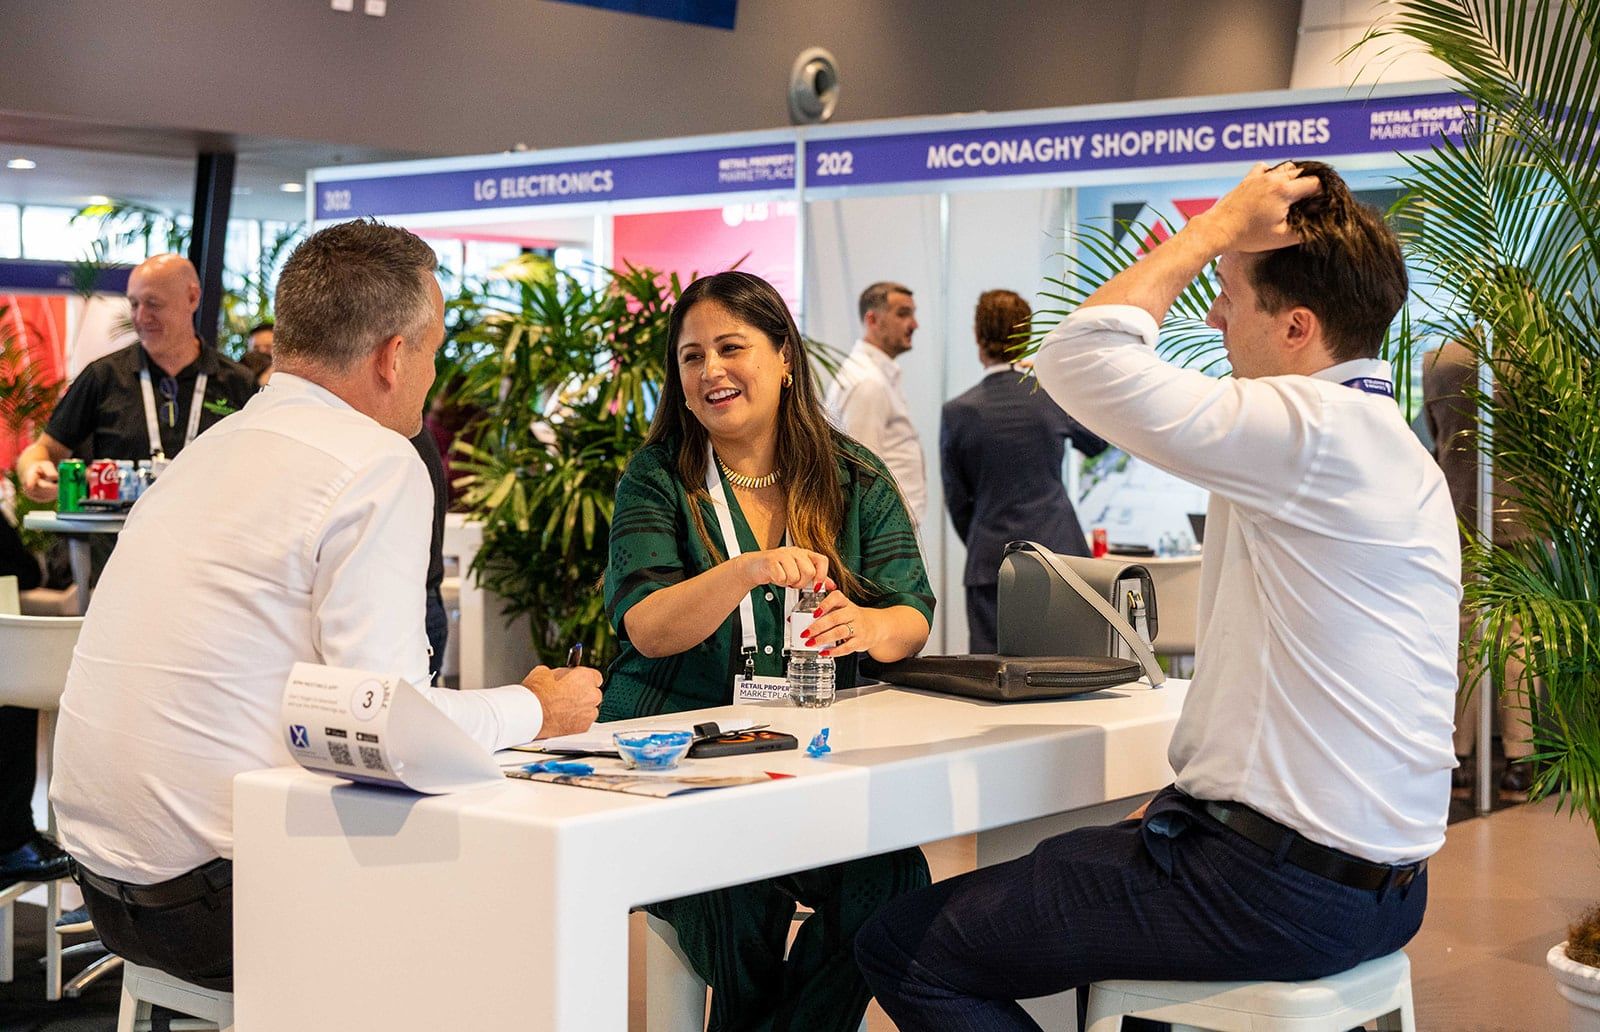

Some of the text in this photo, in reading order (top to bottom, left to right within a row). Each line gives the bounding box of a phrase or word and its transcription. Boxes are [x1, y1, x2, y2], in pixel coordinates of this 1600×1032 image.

[1370, 109, 1412, 124] RETAIL
[926, 117, 1331, 169] MCCONAGHY SHOPPING CENTRES
[816, 151, 853, 176] 202
[474, 170, 614, 201] LG ELECTRONICS
[740, 682, 763, 690] RETAIL
[740, 690, 792, 698] MARKETPLA
[362, 690, 375, 709] 3
